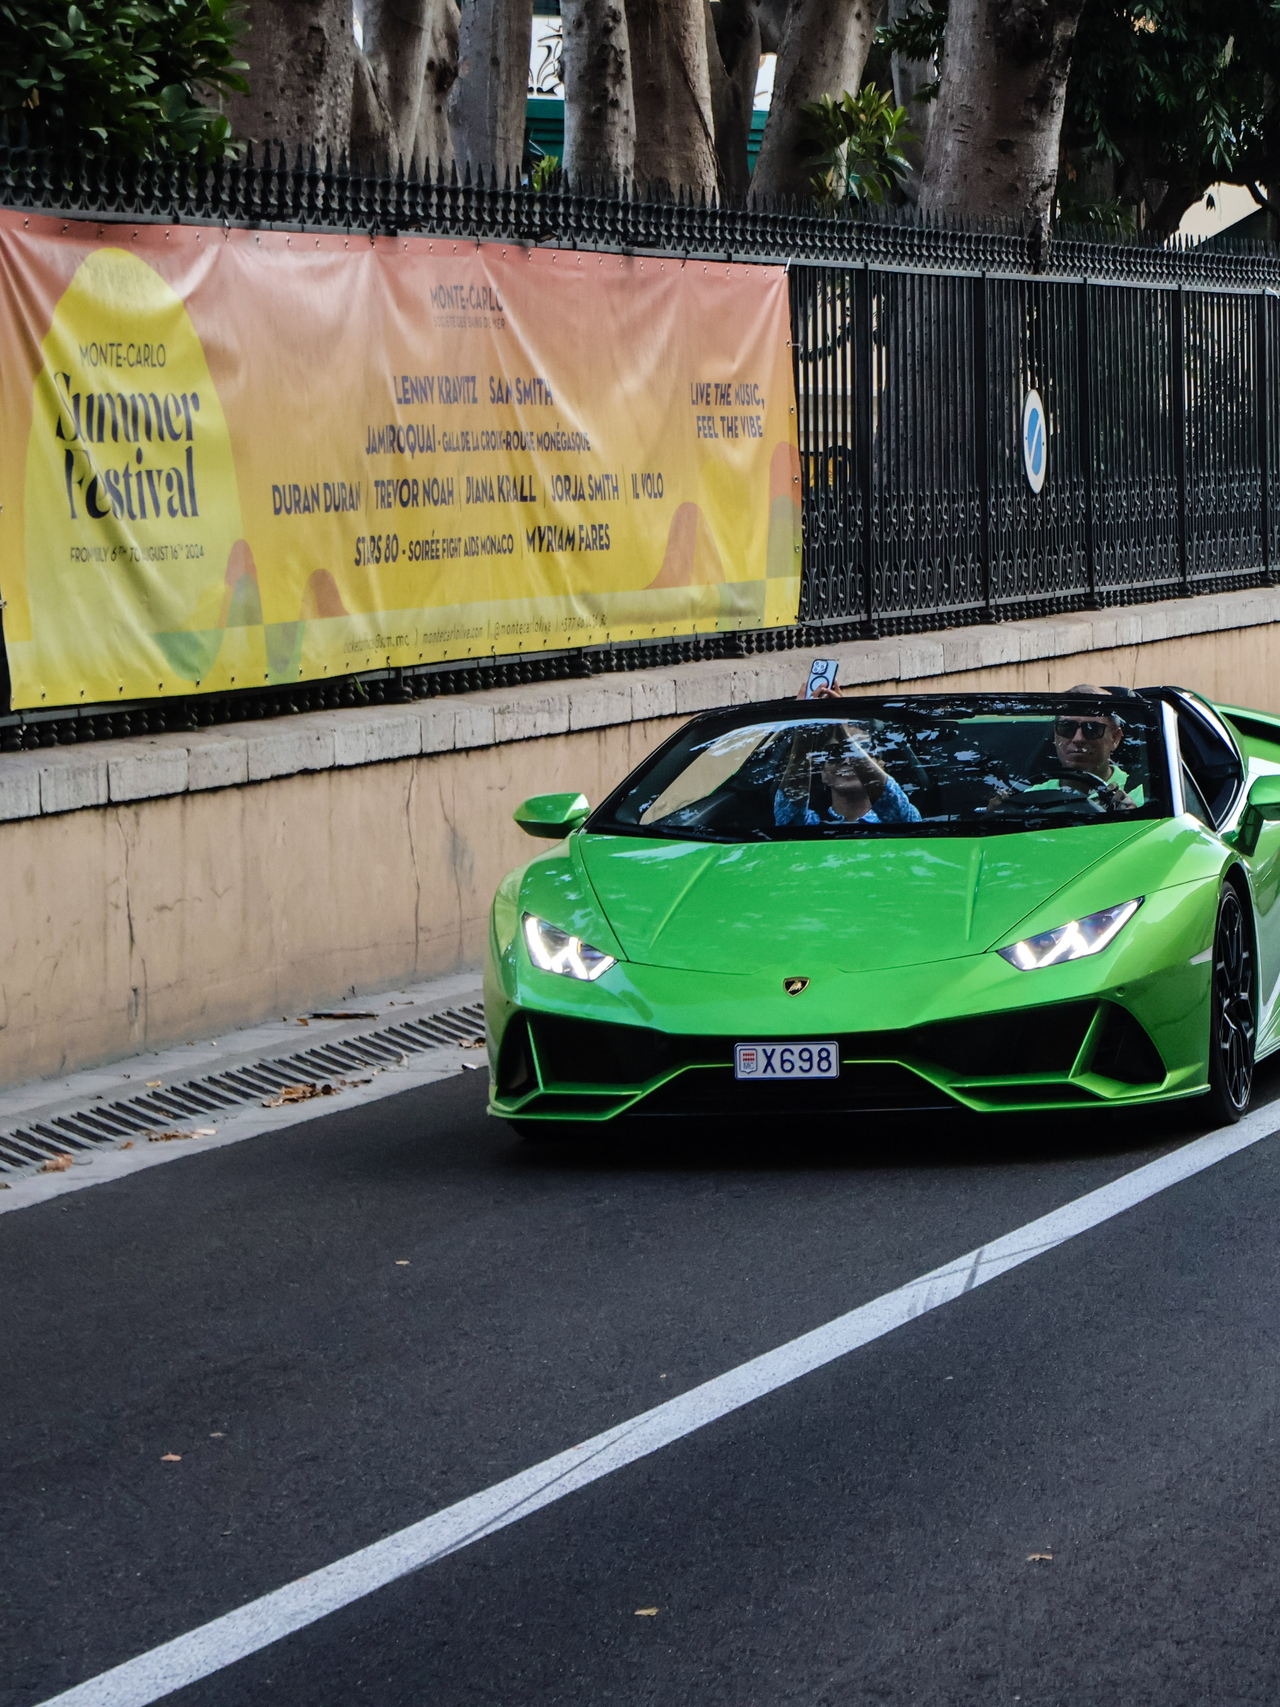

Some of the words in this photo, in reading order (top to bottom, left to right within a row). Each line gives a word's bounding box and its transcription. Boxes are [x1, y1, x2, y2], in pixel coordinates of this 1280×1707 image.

[430, 284, 503, 312] MONTE-CARLO
[79, 342, 166, 368] MONTE-CARLO
[393, 375, 434, 405] LENNY
[437, 375, 478, 405] KRAVITZ
[515, 377, 553, 406] SMITH
[690, 382, 711, 406] LIVE
[714, 383, 732, 406] THE
[734, 383, 765, 410] MUSIC,
[54, 371, 200, 443] Summer
[365, 423, 436, 459] JAMIROQUAI
[442, 431, 460, 452] GALA
[461, 431, 470, 452] DE
[471, 431, 480, 451] LA
[536, 422, 591, 455] MONÉGASQUE
[696, 415, 719, 439] FEEL
[720, 415, 739, 439] THE
[740, 415, 763, 438] VIBE
[64, 445, 200, 521] Festival
[272, 483, 320, 516] DURAN
[323, 481, 361, 513] DURAN
[374, 478, 419, 510] TREVOR
[422, 477, 454, 507] NOAH
[465, 475, 495, 504] DIANA
[497, 475, 537, 503] KRALL
[551, 474, 586, 502] JORJA
[588, 473, 620, 501] SMITH
[631, 473, 640, 500] IL
[641, 472, 664, 499] VOLO
[185, 543, 204, 560] 2024
[354, 534, 382, 567] STARS
[384, 533, 399, 564] 80
[407, 529, 440, 562] SOIRÉE
[441, 536, 462, 560] FIGHT
[463, 535, 479, 557] AIDS
[480, 533, 514, 556] MONACO
[526, 525, 575, 553] MYRIAM
[578, 523, 611, 552] FARES
[762, 1047, 832, 1074] X698
